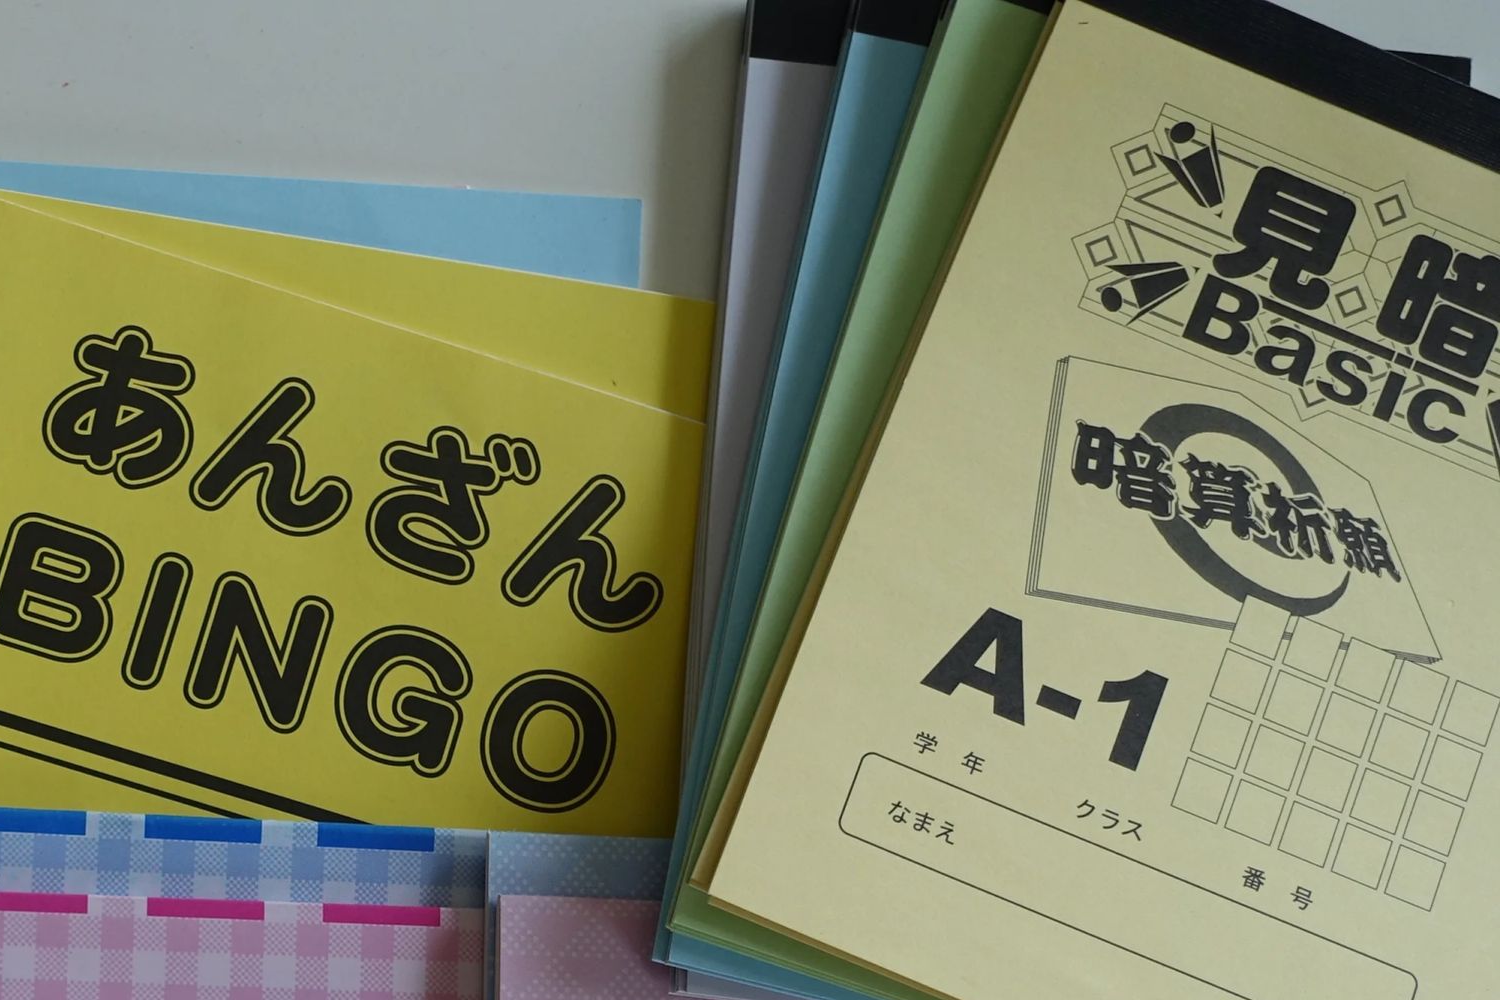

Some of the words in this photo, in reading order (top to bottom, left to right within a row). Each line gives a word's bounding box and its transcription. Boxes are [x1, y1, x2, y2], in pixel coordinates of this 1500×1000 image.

[1182, 273, 1466, 444] Basic
[42, 325, 664, 633] あんざん
[1071, 419, 1402, 583] 暗算祈願
[920, 607, 1169, 772] A-1
[887, 800, 956, 846] なまえ
[1076, 798, 1143, 841] クラス
